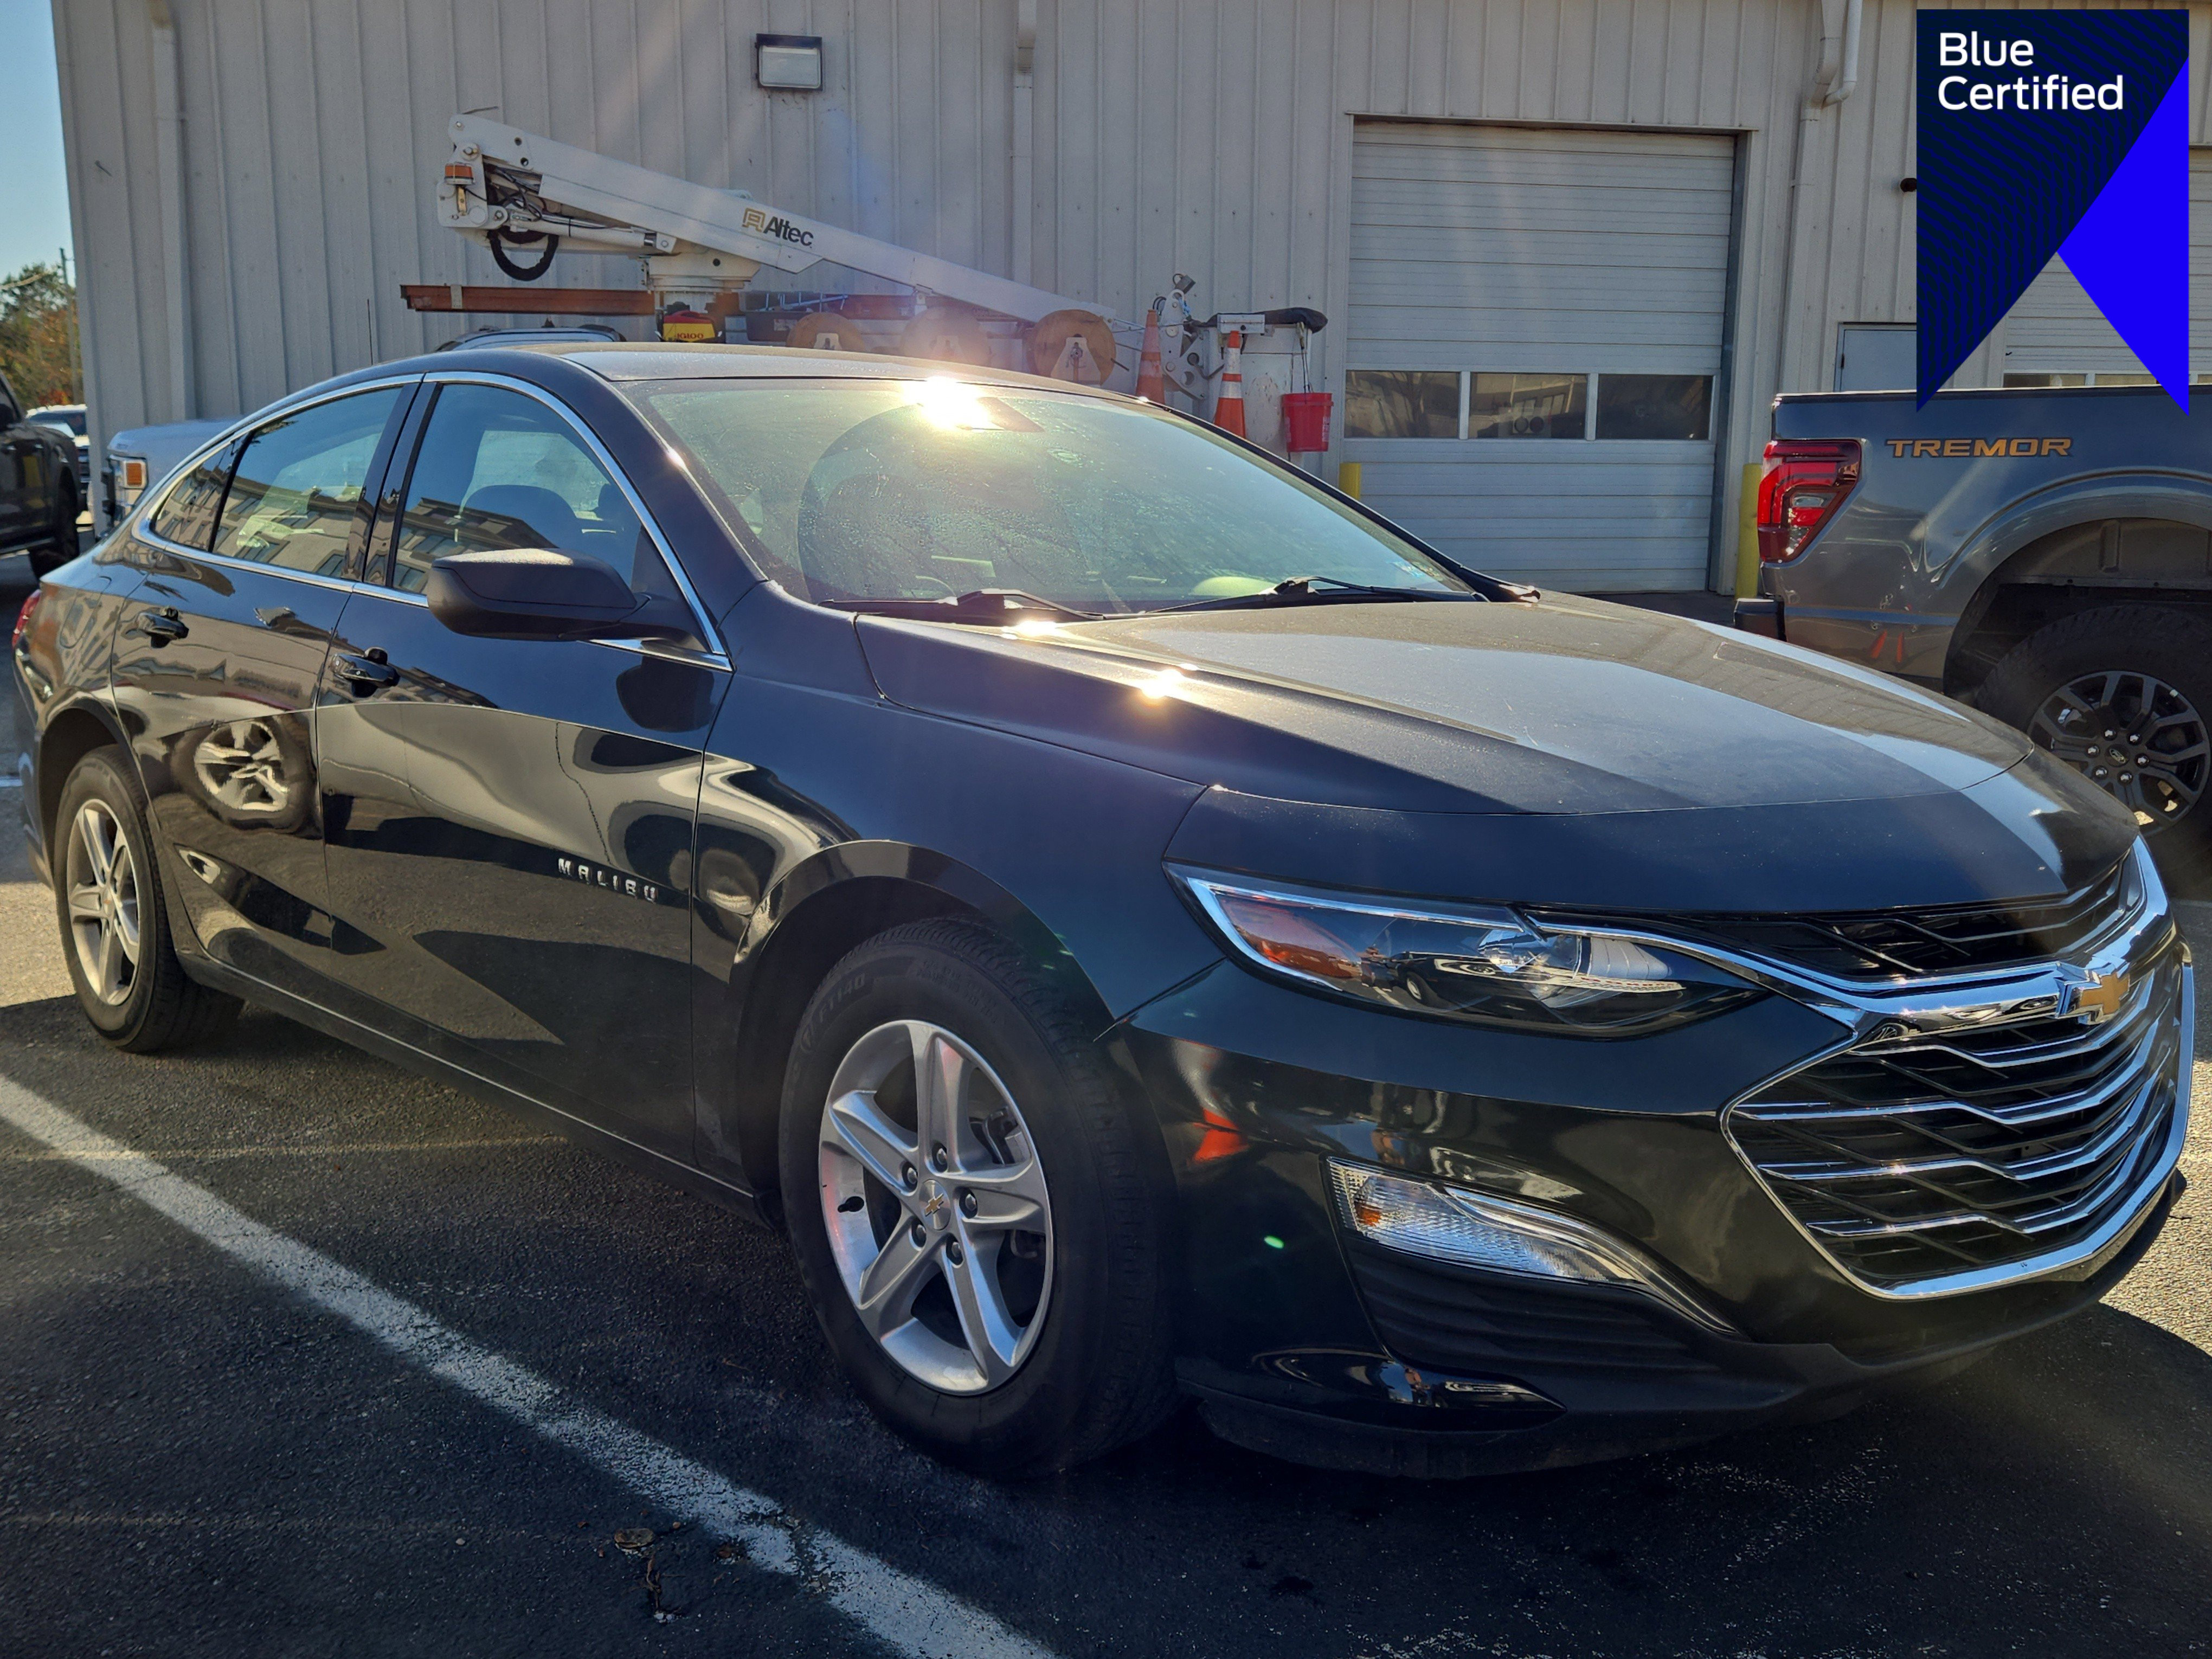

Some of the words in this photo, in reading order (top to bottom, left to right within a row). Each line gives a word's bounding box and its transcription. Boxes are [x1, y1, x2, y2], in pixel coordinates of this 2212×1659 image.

[763, 216, 814, 247] Altec
[1886, 438, 2072, 457] TREMOR
[558, 858, 657, 904] MALIBU
